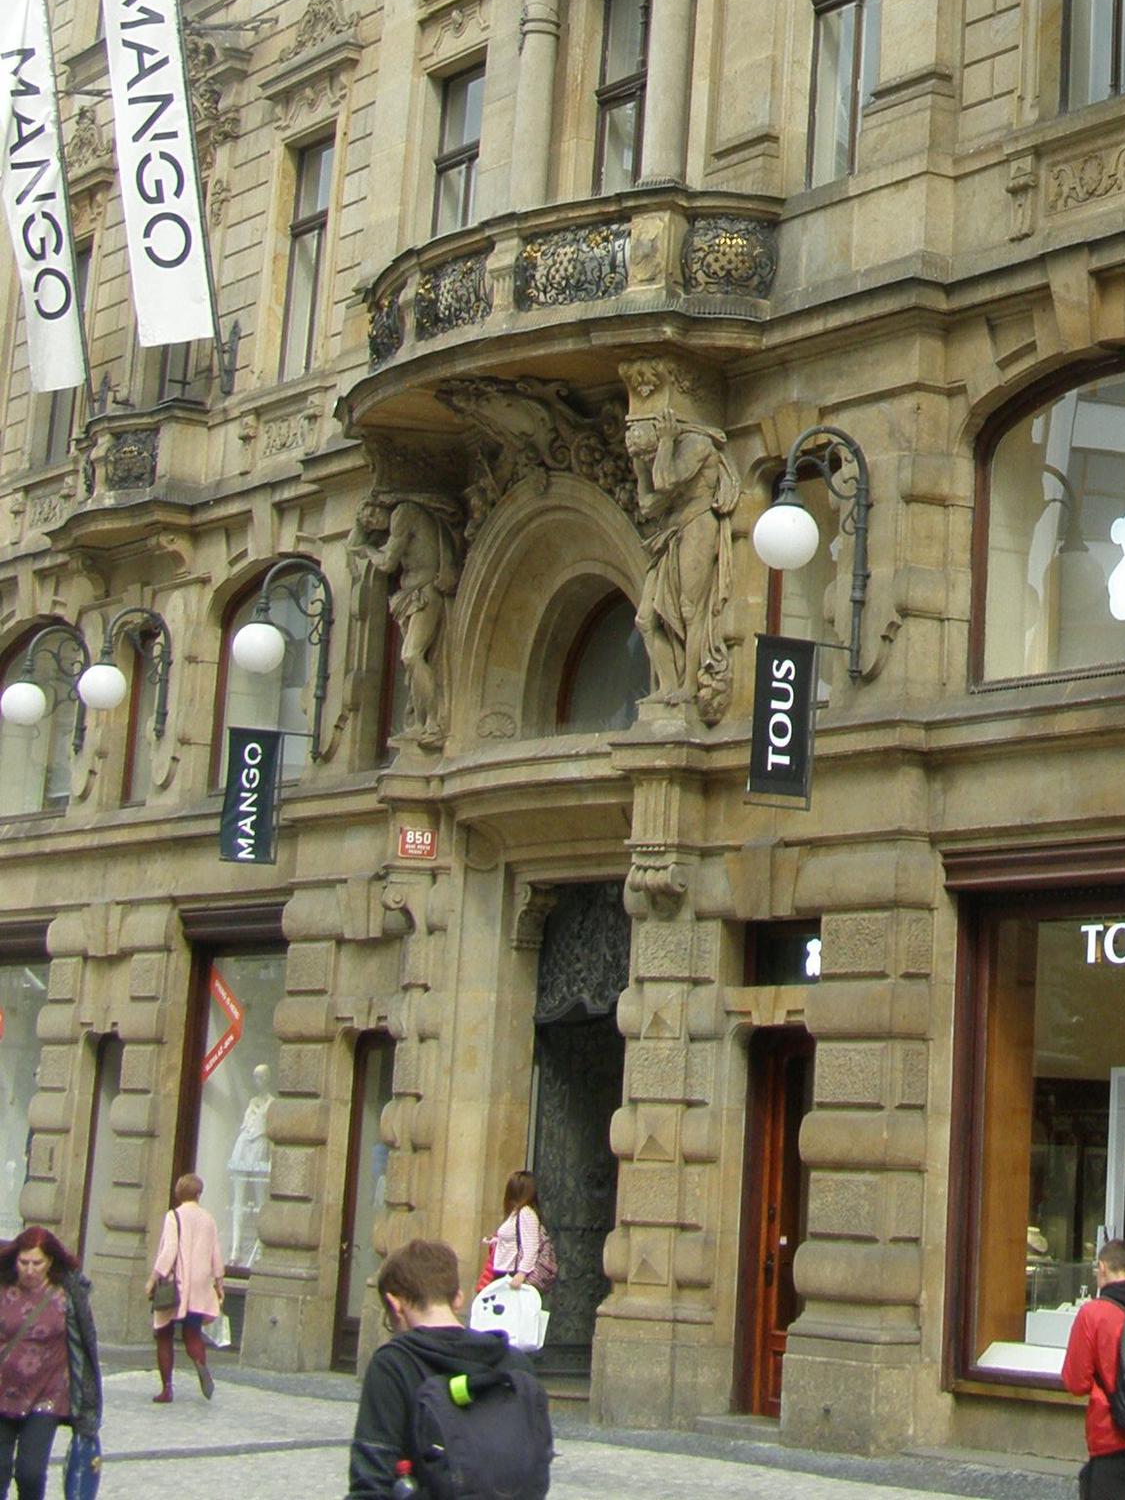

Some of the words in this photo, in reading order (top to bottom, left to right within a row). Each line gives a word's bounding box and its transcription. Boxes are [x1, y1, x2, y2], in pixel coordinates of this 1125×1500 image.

[1, 47, 72, 321] MANGO
[767, 659, 796, 771] TOUS
[237, 742, 262, 859] MANGO
[406, 830, 432, 845] 850
